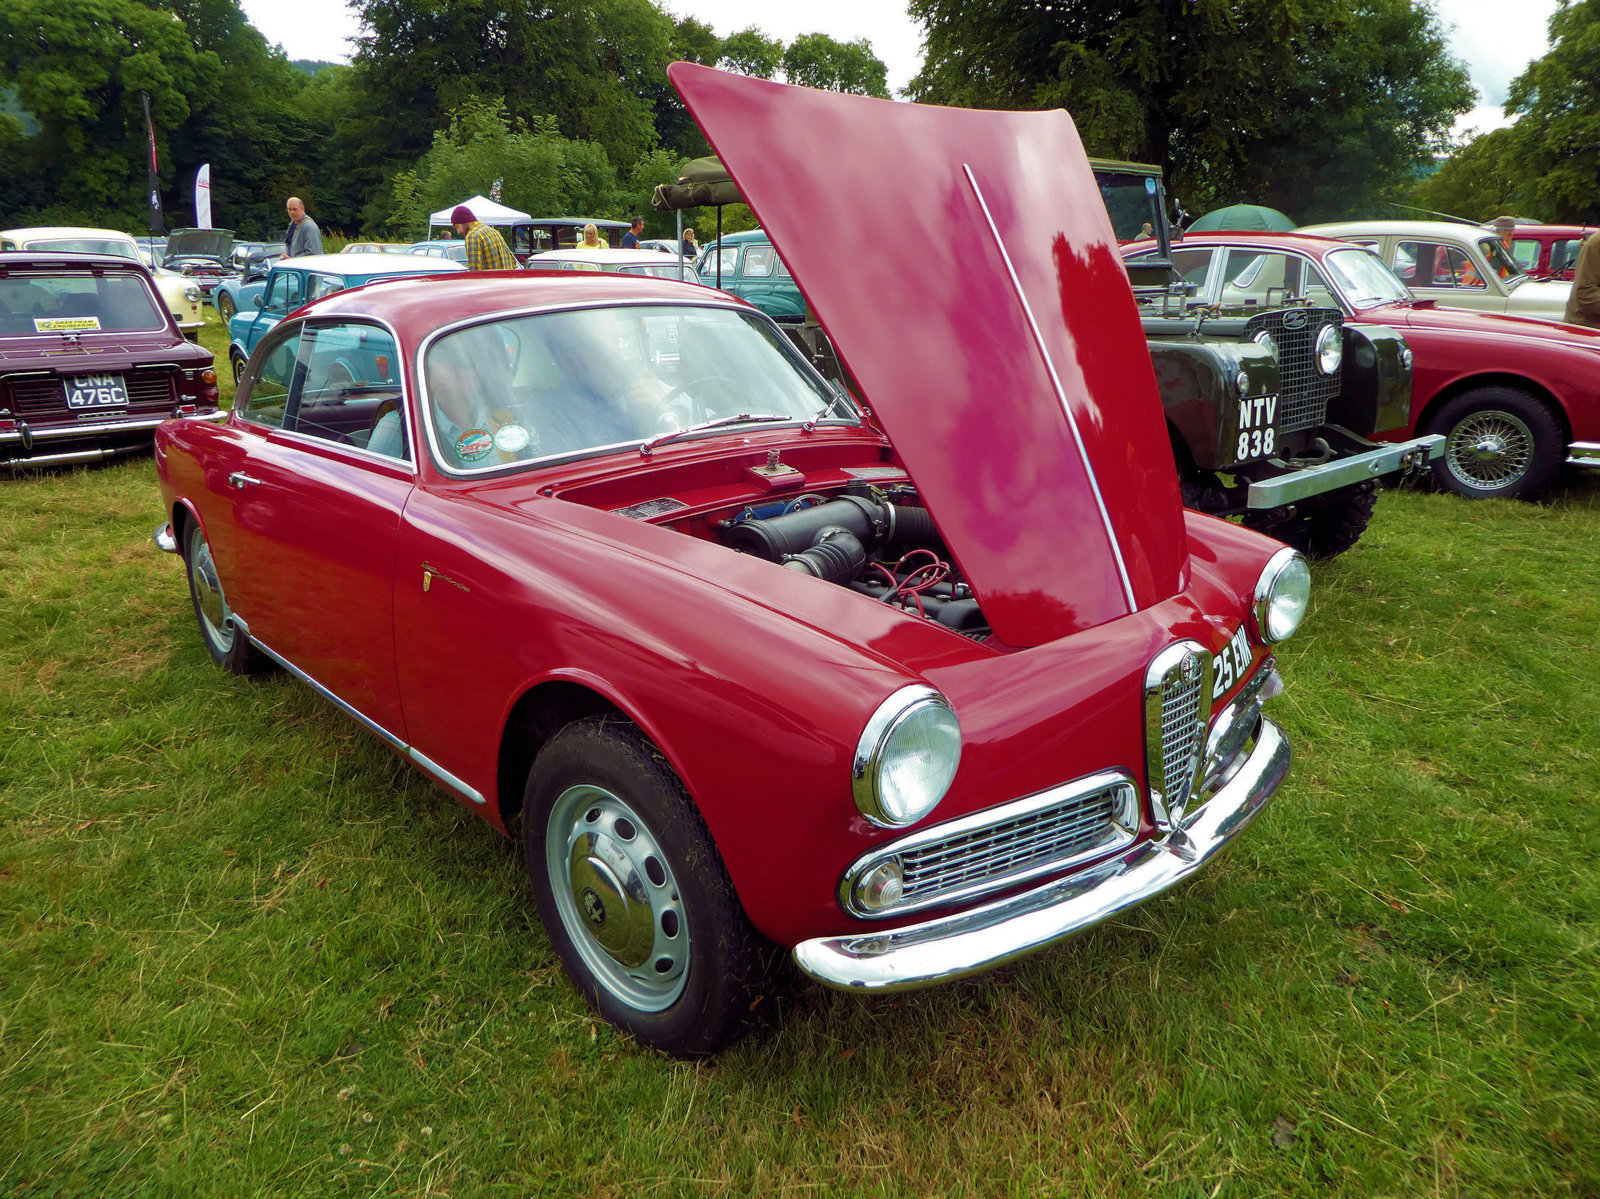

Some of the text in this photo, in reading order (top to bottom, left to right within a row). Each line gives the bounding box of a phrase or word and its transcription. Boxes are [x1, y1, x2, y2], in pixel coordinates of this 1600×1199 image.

[71, 387, 125, 405] 476C
[1239, 396, 1277, 429] NTV
[1237, 427, 1275, 460] 838
[1212, 646, 1233, 699] 25
